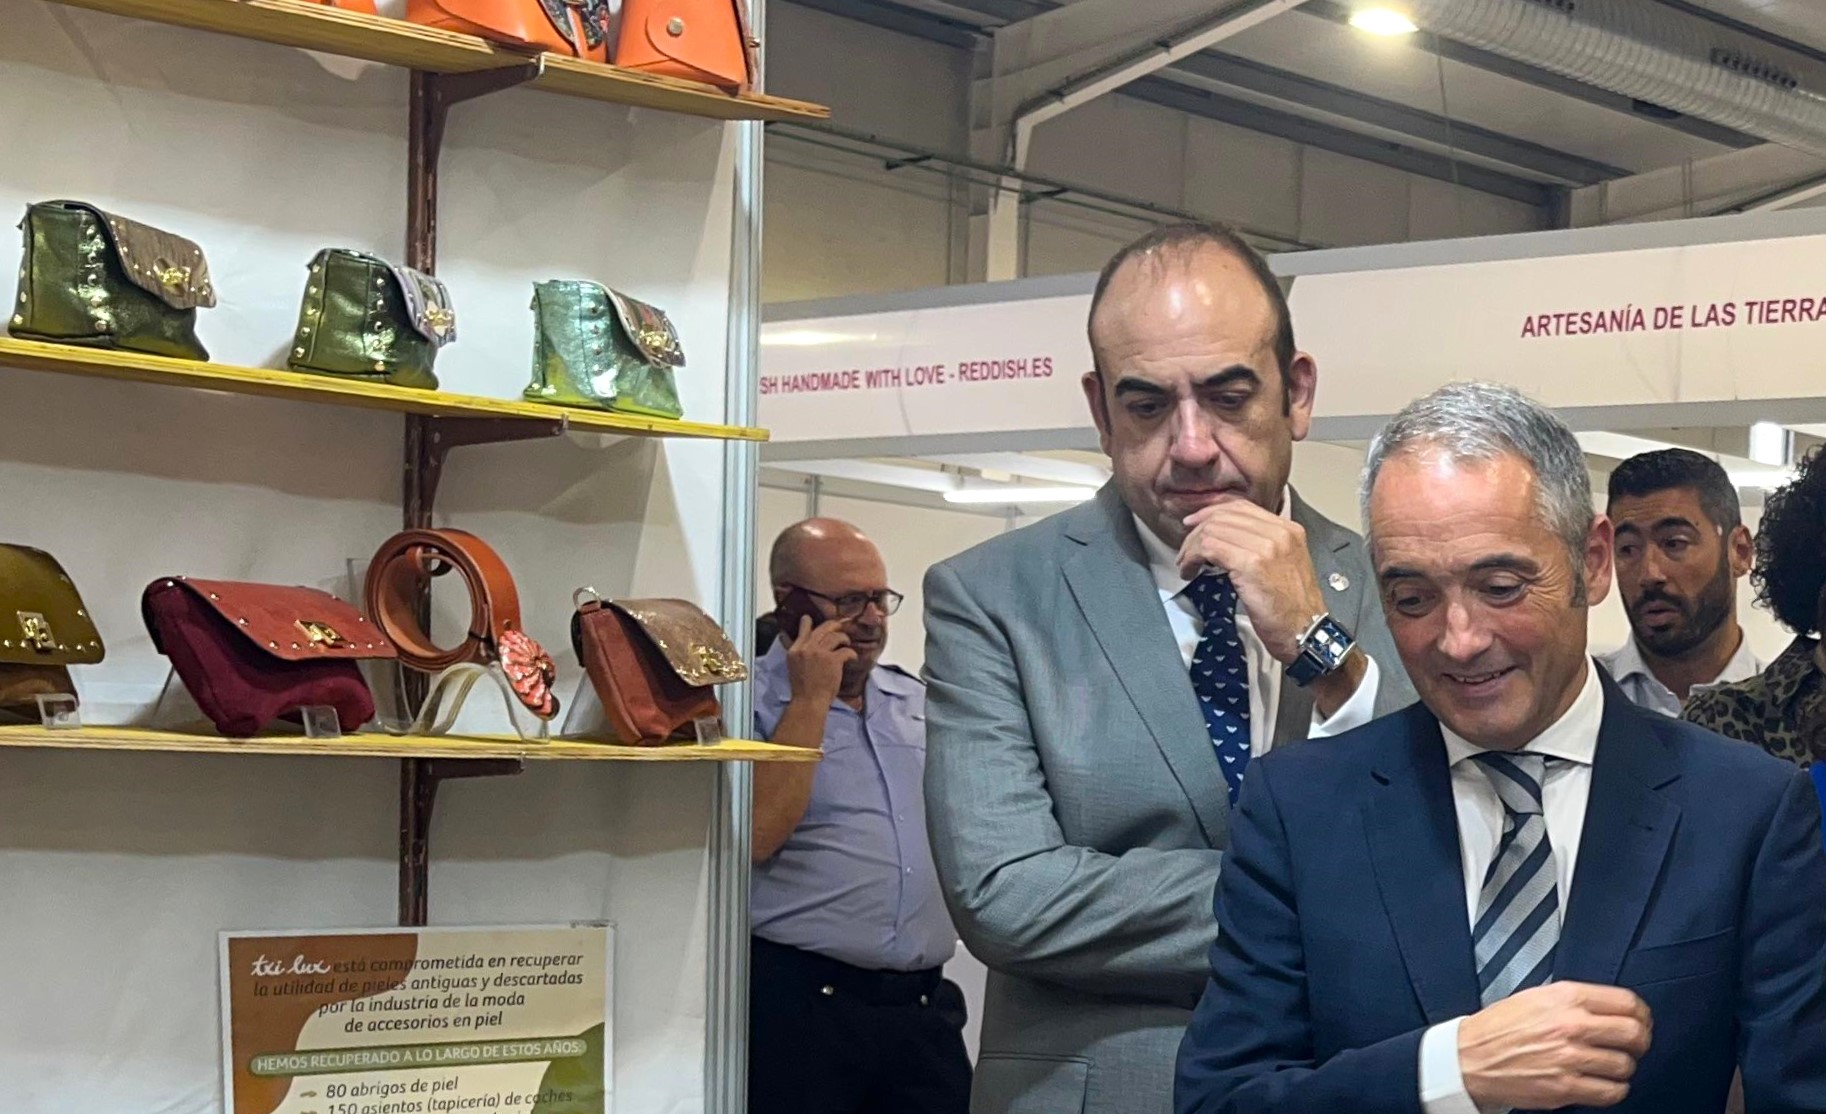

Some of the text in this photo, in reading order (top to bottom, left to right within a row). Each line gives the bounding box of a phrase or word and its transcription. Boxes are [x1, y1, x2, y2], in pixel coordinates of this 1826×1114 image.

[1521, 303, 1646, 338] ARTESANÍA
[1653, 306, 1684, 331] DE
[1690, 302, 1736, 328] LAS
[782, 370, 860, 393] HANDMADE
[865, 368, 901, 388] WITH
[905, 364, 945, 386] LOVE
[958, 357, 1053, 382] REDDISH.ES
[333, 958, 366, 973] está
[370, 954, 484, 975] comprometida
[488, 956, 505, 968] en
[510, 954, 583, 970] recuperar
[254, 970, 583, 996] la utilidad de pieles antiguas y descartadas
[318, 991, 525, 1018] por la industria de la moda
[344, 1011, 503, 1033] de accesorios en piel
[257, 1056, 308, 1071] HEMOS
[311, 1051, 400, 1068] RECUPERADO
[403, 1050, 413, 1062] A
[416, 1049, 433, 1061] LO
[436, 1046, 480, 1060] LARGO
[482, 1045, 499, 1057] DE
[503, 1043, 541, 1057] ESTOS
[326, 1076, 459, 1099] 80 abrigos de piel
[427, 1093, 500, 1113] (tapicería)
[504, 1091, 522, 1105] de
[525, 1089, 573, 1104] coches
